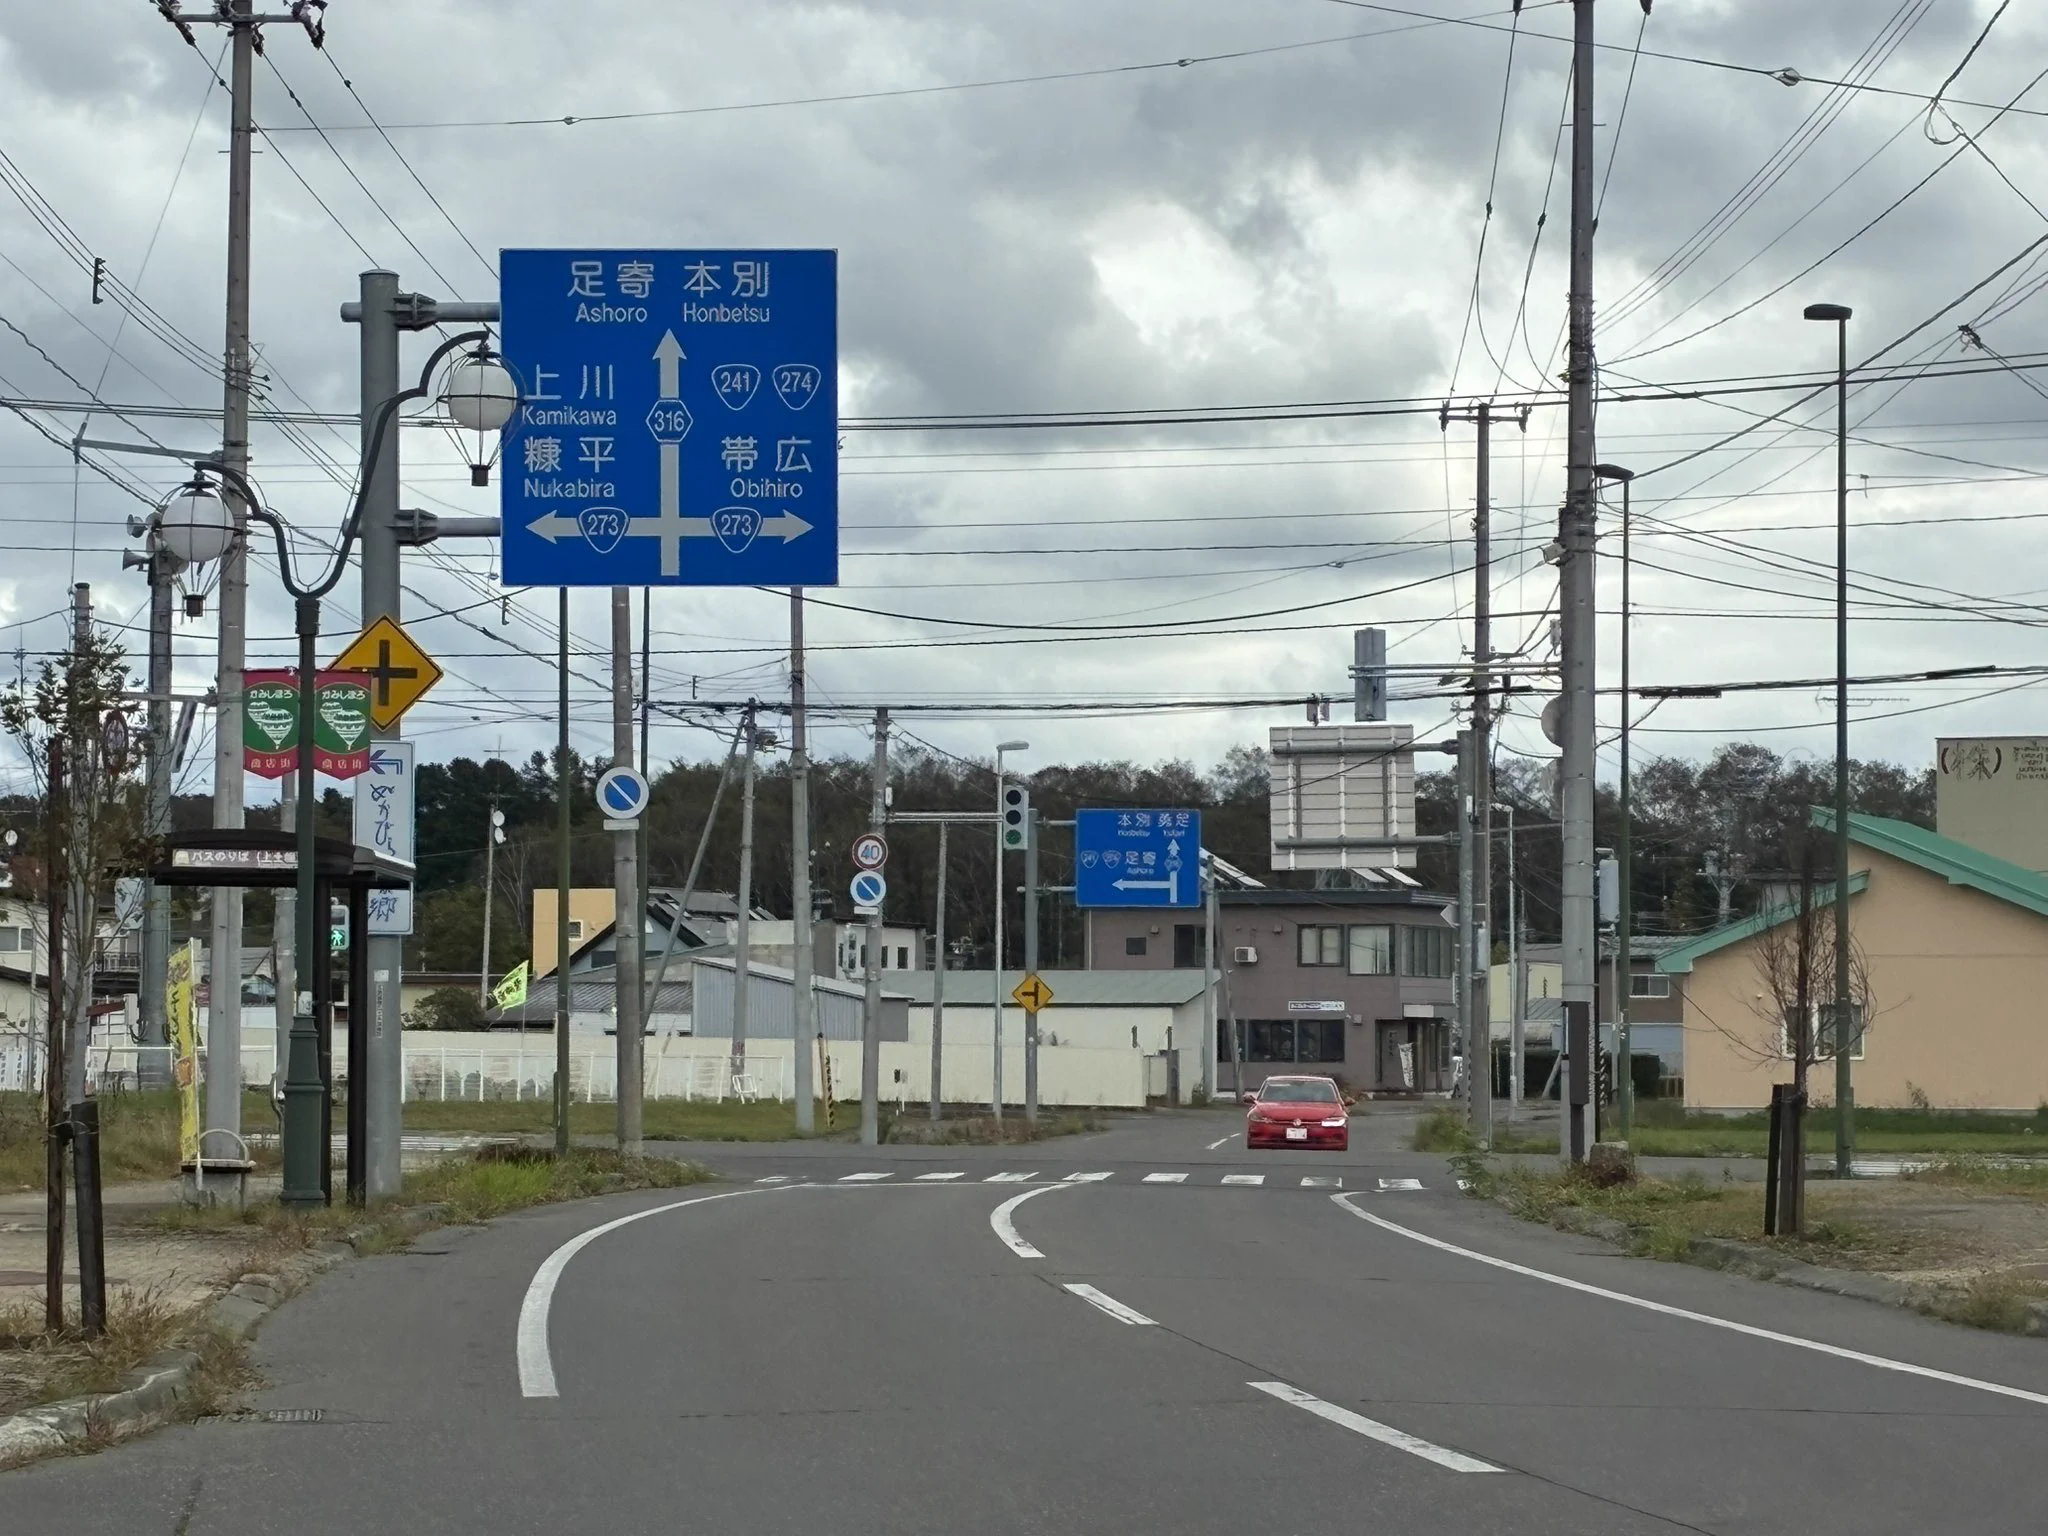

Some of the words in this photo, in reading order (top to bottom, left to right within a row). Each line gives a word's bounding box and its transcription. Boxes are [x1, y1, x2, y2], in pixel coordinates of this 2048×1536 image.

[567, 260, 655, 298] 足寄
[683, 260, 770, 298] 本別
[575, 303, 648, 323] Ashoro
[683, 303, 770, 323] Honbetsu
[523, 364, 614, 400] 上川
[720, 371, 751, 392] 241
[781, 371, 812, 392] 274
[522, 405, 617, 425] Kamikawa
[654, 410, 685, 431] 316
[524, 437, 615, 473] 糠平
[721, 436, 812, 473] 帯広
[524, 478, 615, 498] Nukabira
[730, 478, 803, 498] Obihiro
[587, 515, 618, 536] 273
[720, 515, 752, 536] 273
[1117, 812, 1151, 828] 本別
[860, 844, 880, 860] 40
